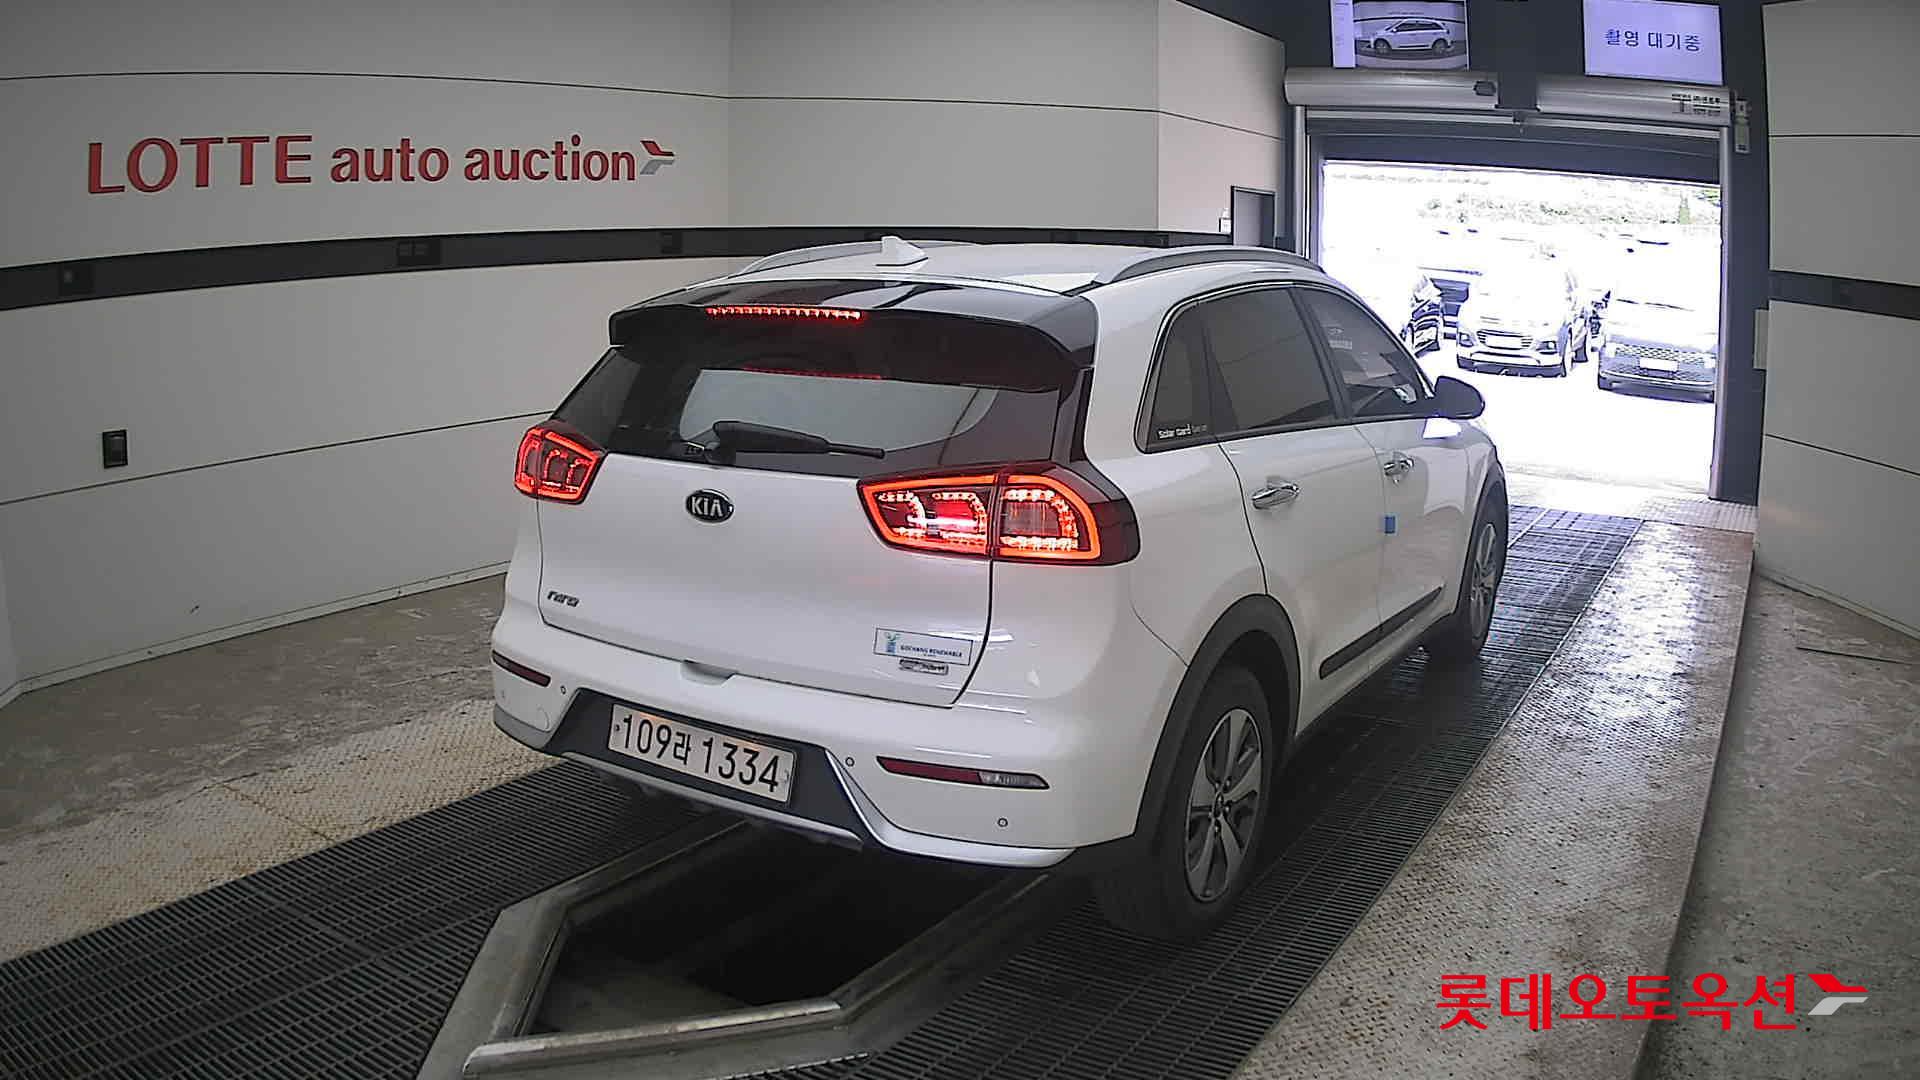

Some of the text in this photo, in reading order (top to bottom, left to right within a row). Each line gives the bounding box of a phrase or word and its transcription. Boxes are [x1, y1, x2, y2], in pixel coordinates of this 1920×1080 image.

[1604, 29, 1701, 51] 촬영 대기중
[87, 134, 636, 194] LOTTE auto auction
[690, 496, 724, 517] KIA
[929, 647, 963, 658] RENEWABLE
[623, 714, 780, 793] 109라 1334
